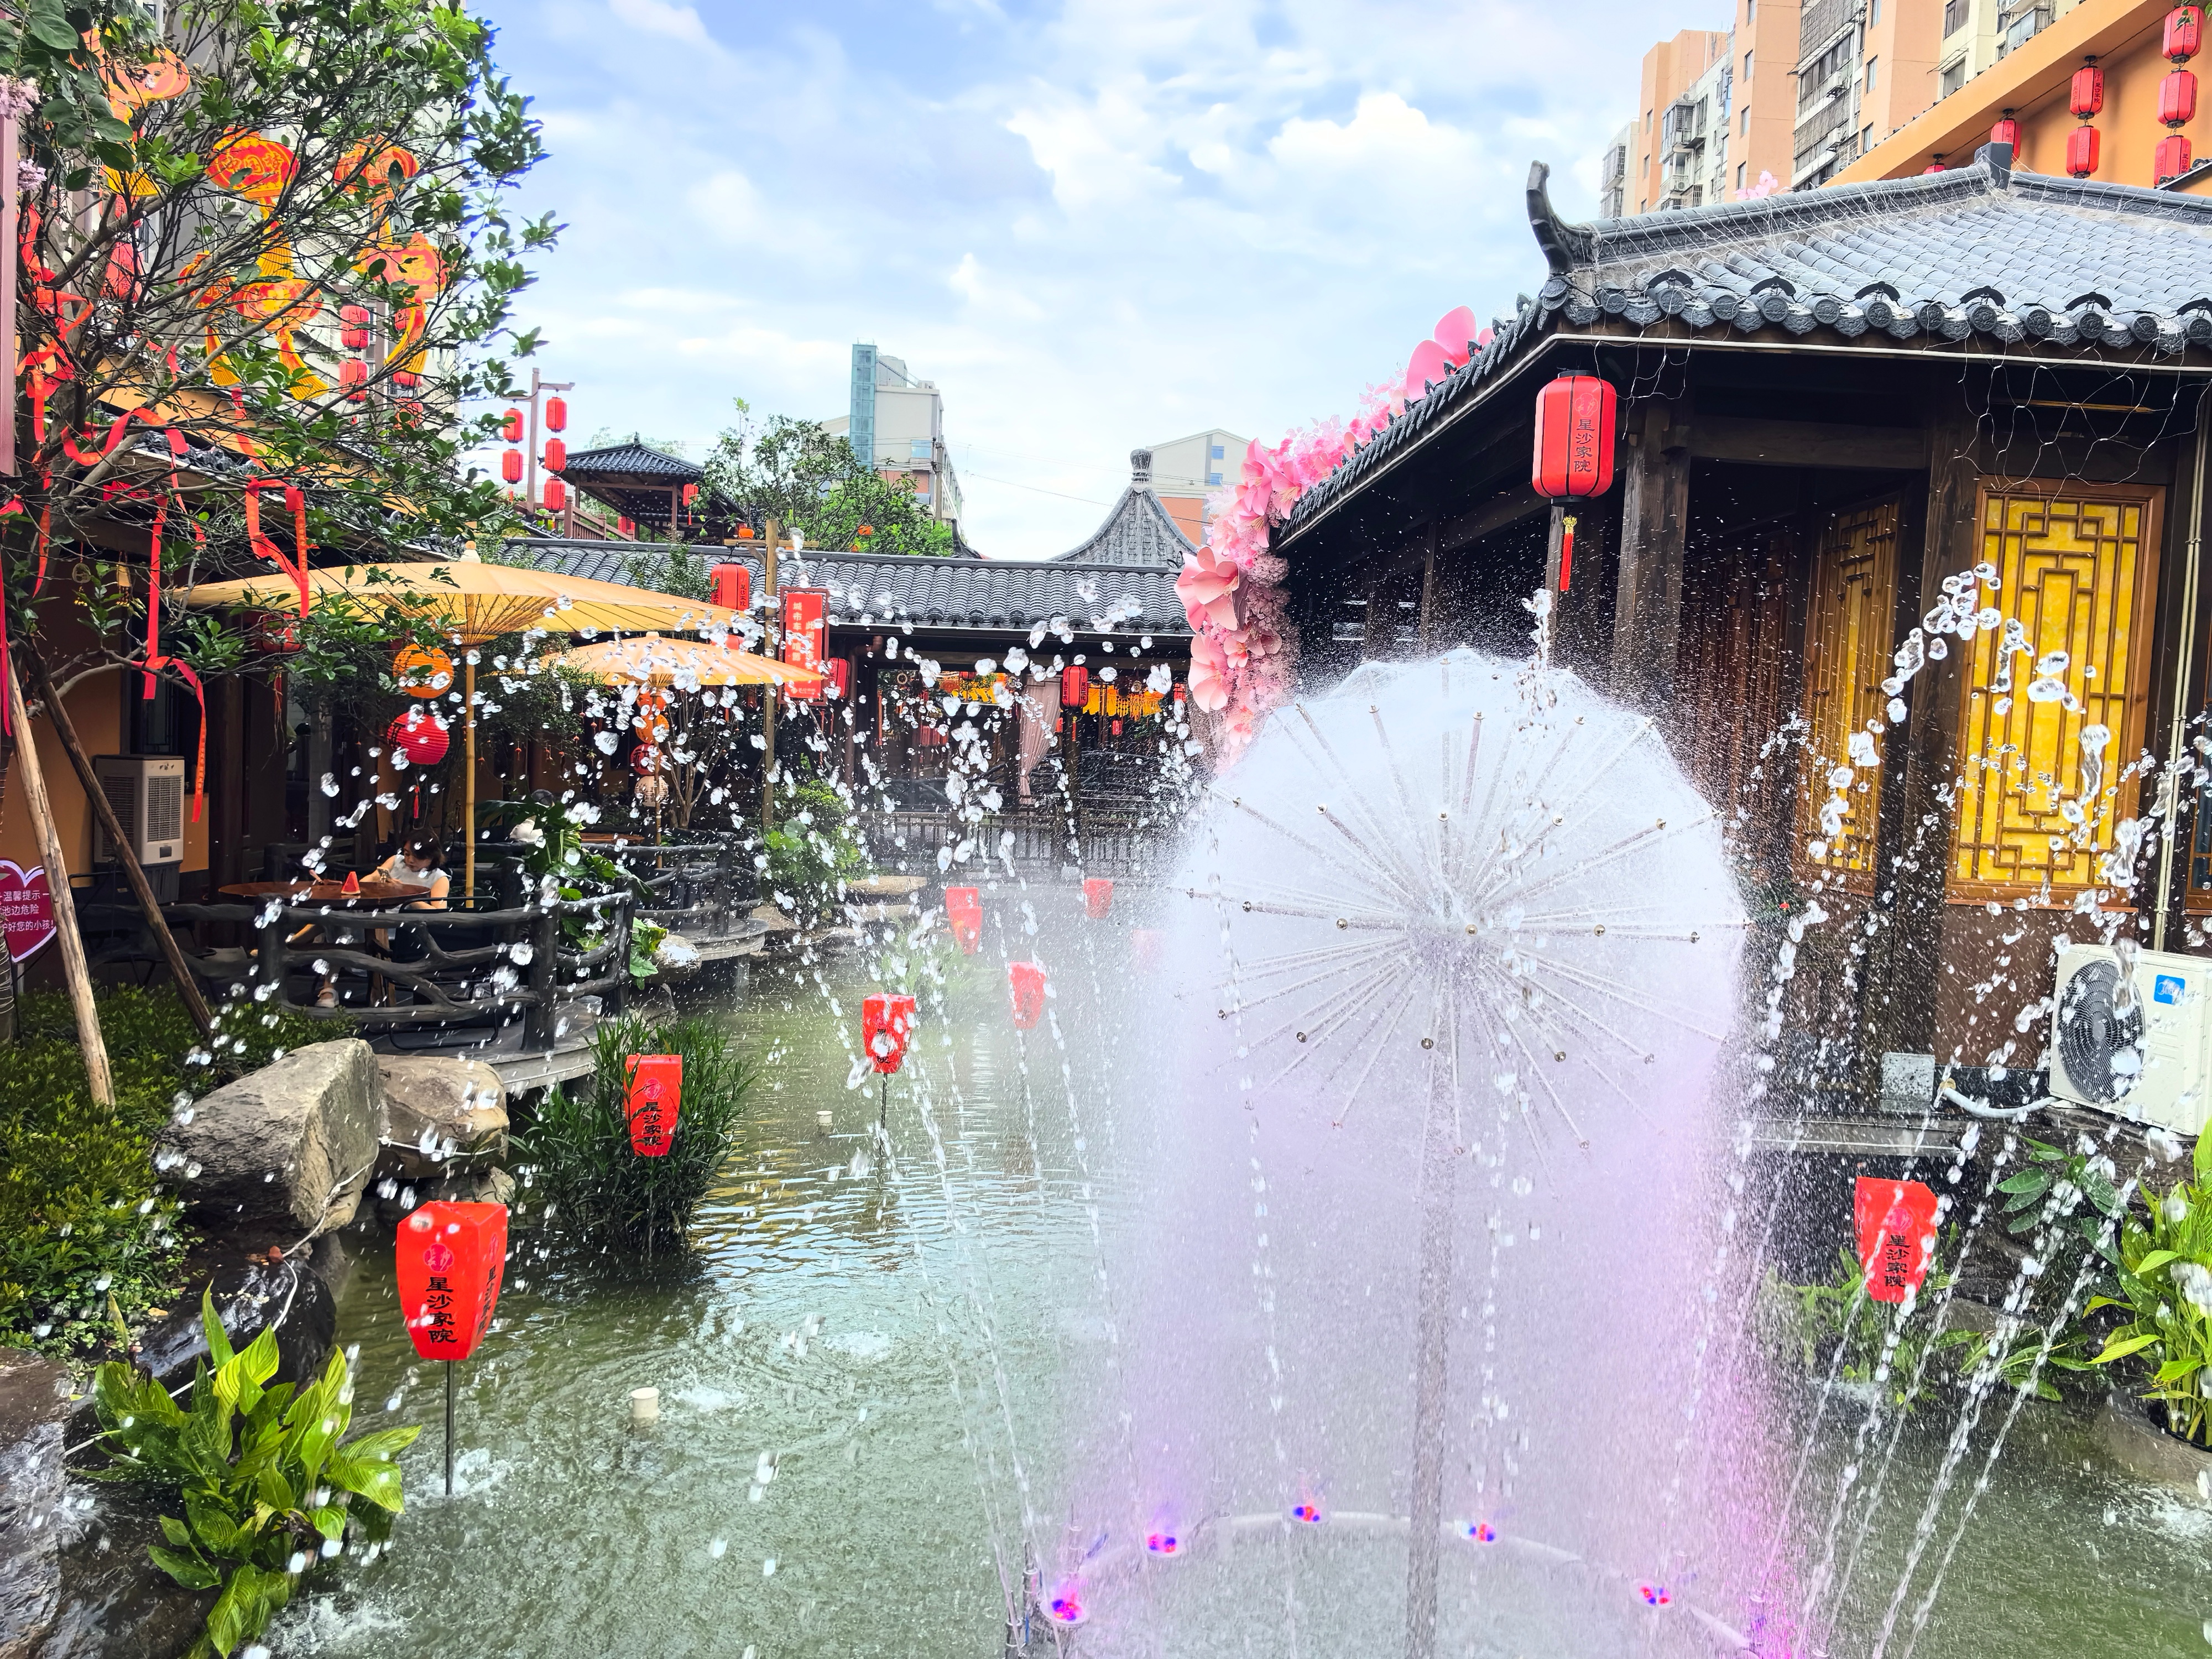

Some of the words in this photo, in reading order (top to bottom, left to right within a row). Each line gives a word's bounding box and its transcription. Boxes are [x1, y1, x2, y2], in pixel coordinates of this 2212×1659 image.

[1573, 419, 1595, 472] 星沙家院
[643, 1101, 664, 1146] 星沙家院
[425, 1276, 458, 1344] 星沙家院
